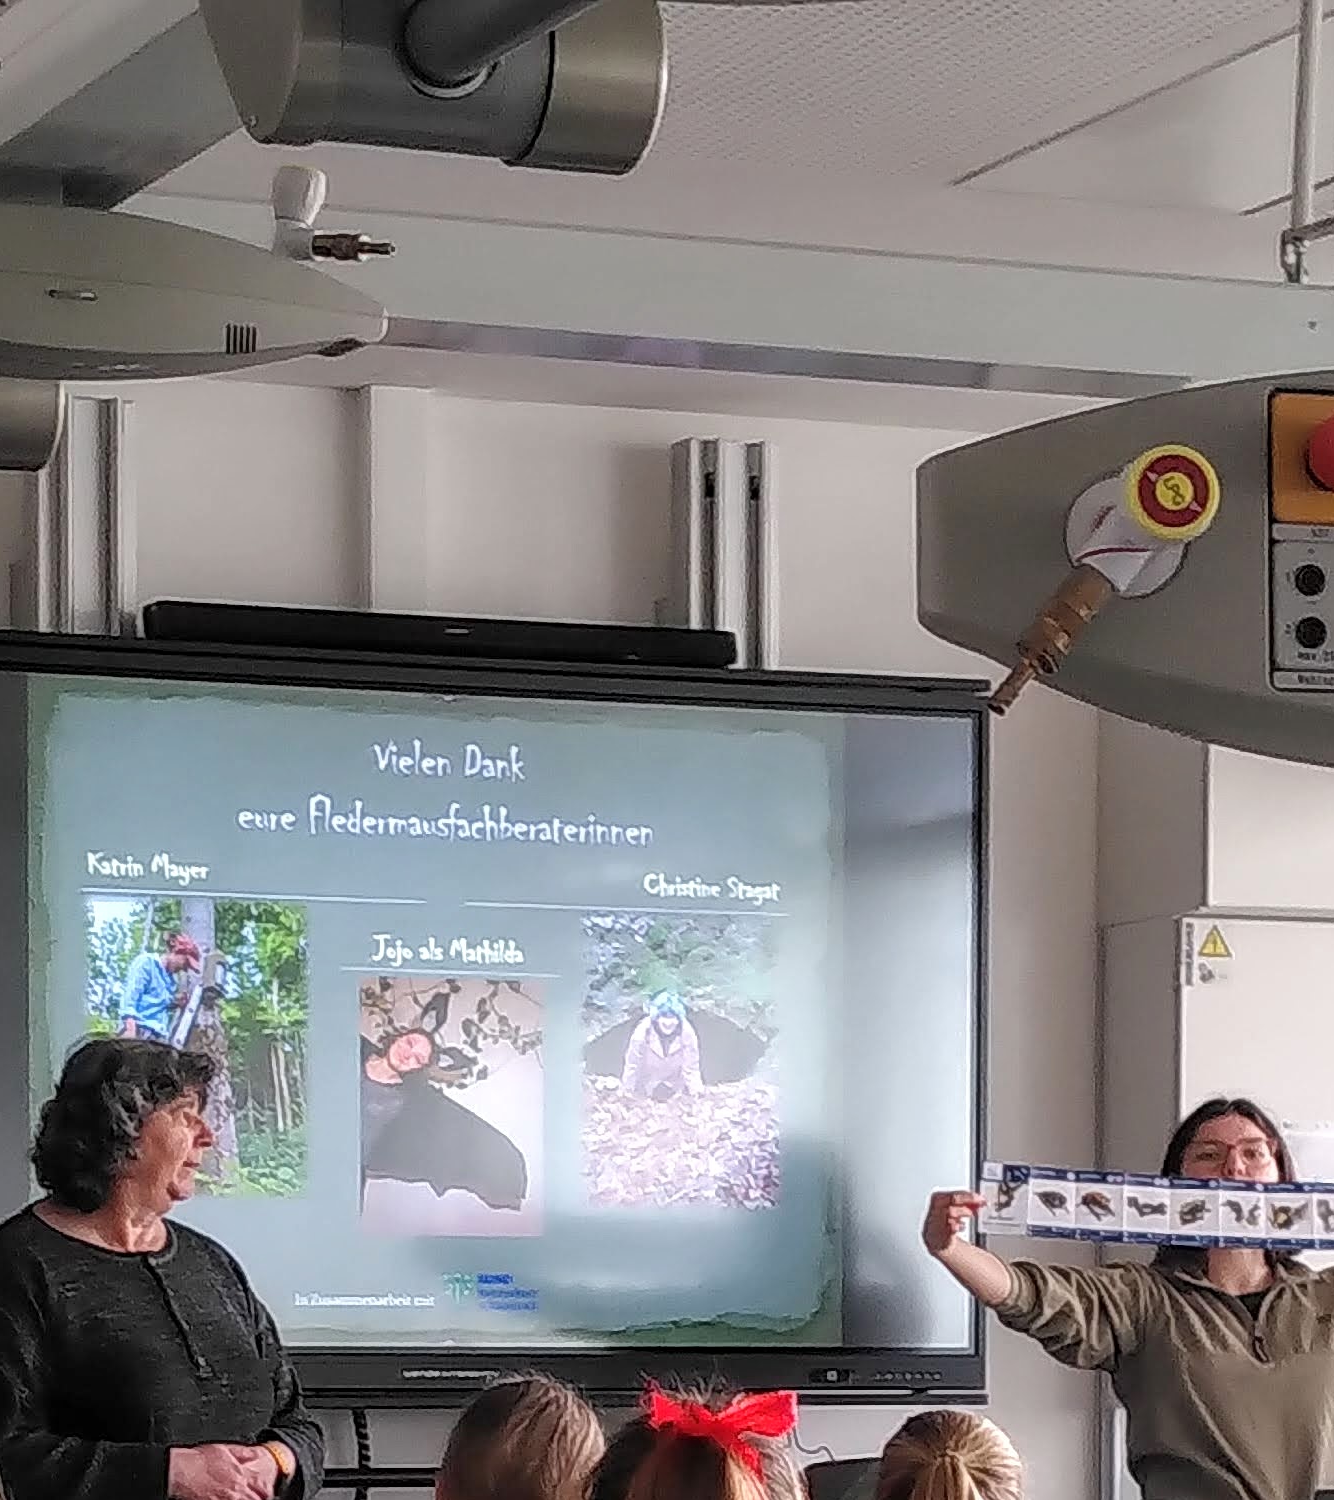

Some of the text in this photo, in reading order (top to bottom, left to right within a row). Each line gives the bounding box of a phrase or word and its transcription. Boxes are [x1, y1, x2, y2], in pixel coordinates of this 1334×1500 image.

[372, 737, 526, 782] Vielen Dank
[236, 808, 296, 832] eure
[87, 851, 210, 886] Katrin Mayer
[643, 873, 721, 898] Christine
[371, 933, 524, 966] Jojo als Mathilda
